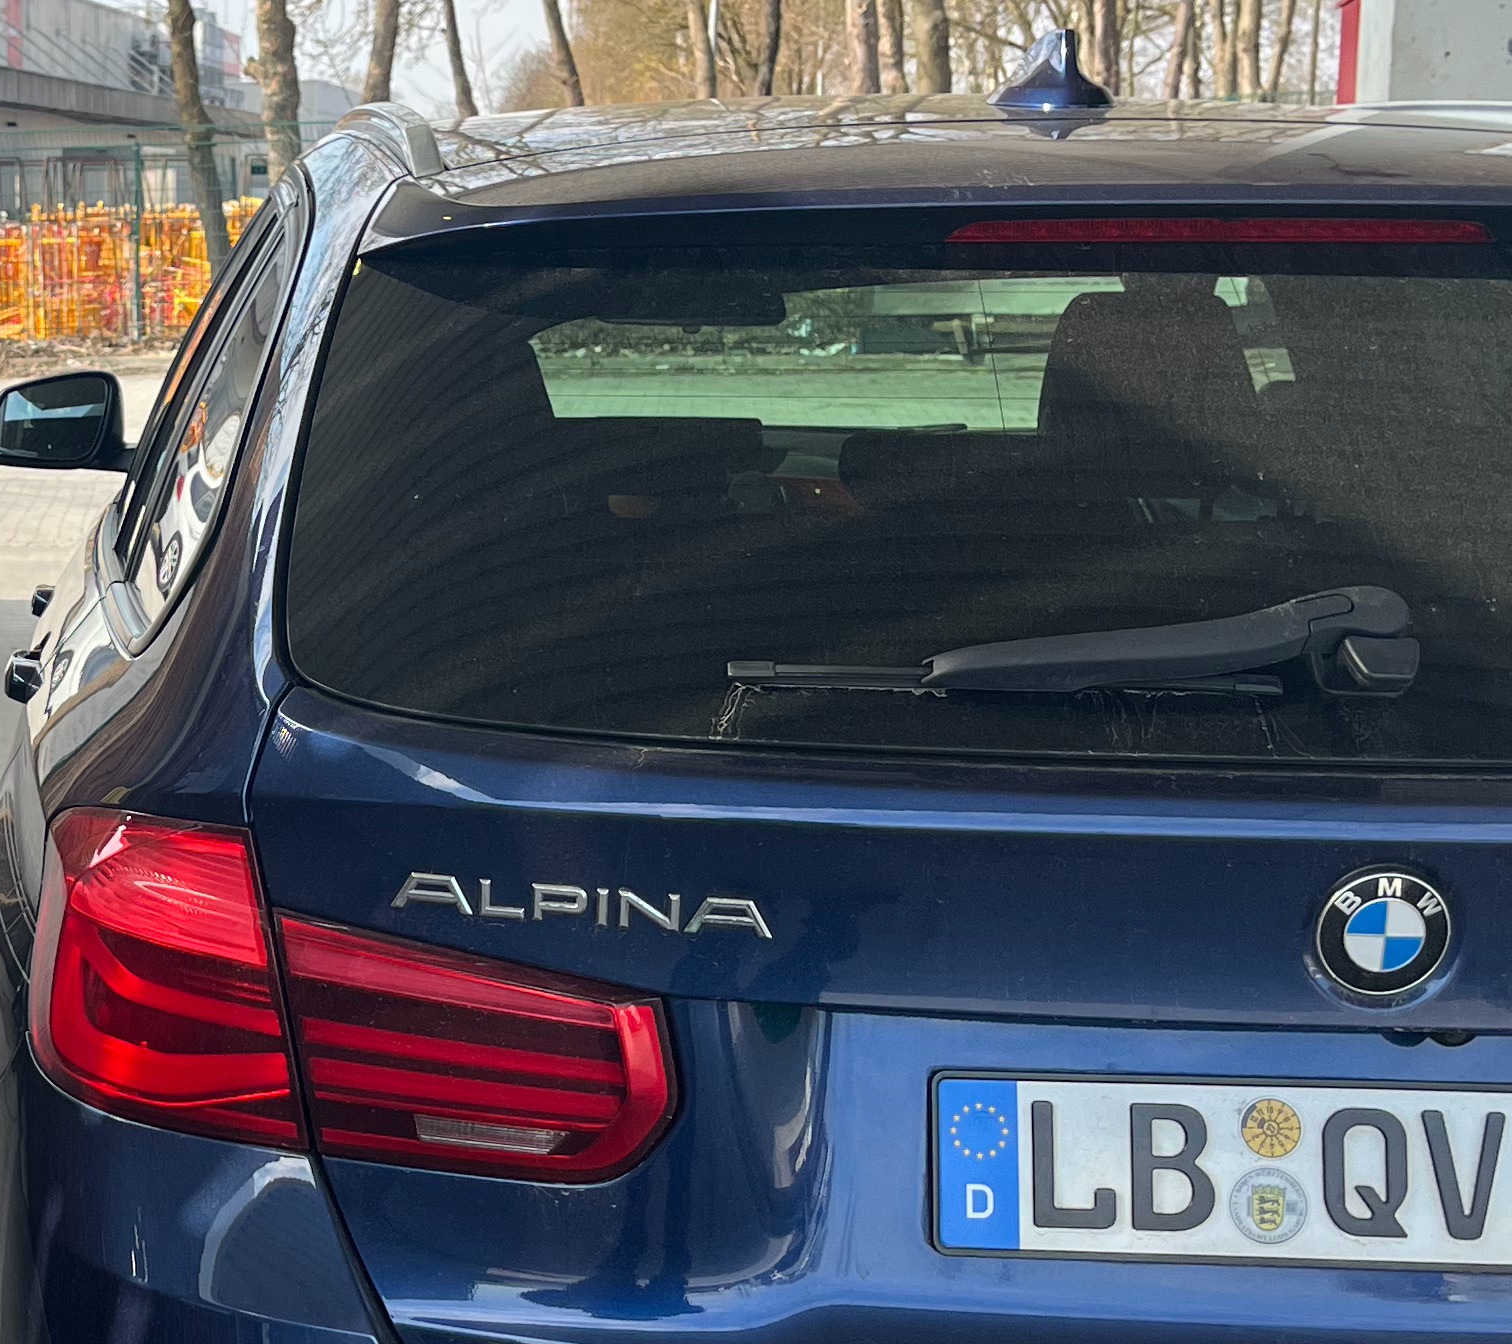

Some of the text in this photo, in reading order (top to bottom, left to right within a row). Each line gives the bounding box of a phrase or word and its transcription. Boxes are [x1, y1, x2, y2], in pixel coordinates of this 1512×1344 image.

[391, 871, 773, 939] ALPINA
[1334, 877, 1443, 918] BMW
[1031, 1100, 1506, 1241] LB QV
[966, 1183, 994, 1219] D
